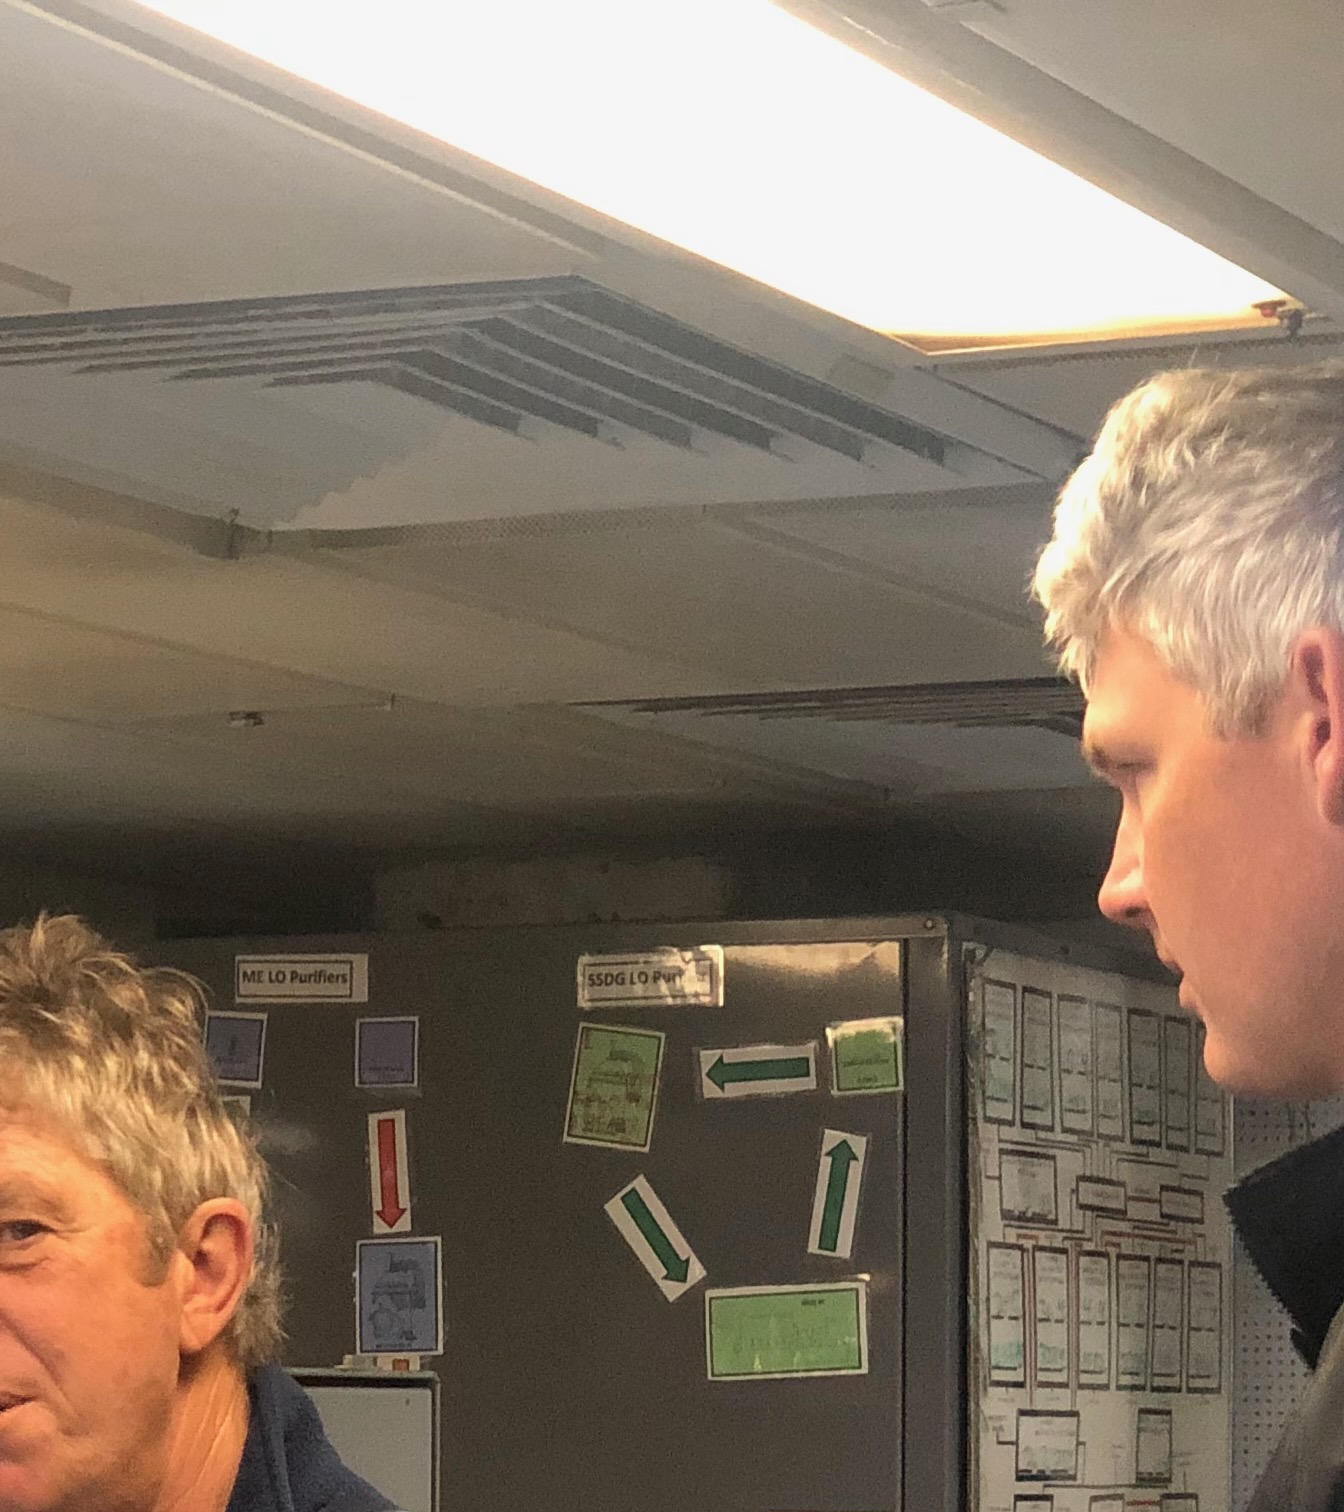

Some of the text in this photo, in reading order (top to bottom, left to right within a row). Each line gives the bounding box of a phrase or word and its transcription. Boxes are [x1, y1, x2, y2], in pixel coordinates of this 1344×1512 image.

[242, 969, 348, 984] ME LO Purifiers
[587, 972, 625, 987] SSDG
[629, 971, 648, 985] LO
